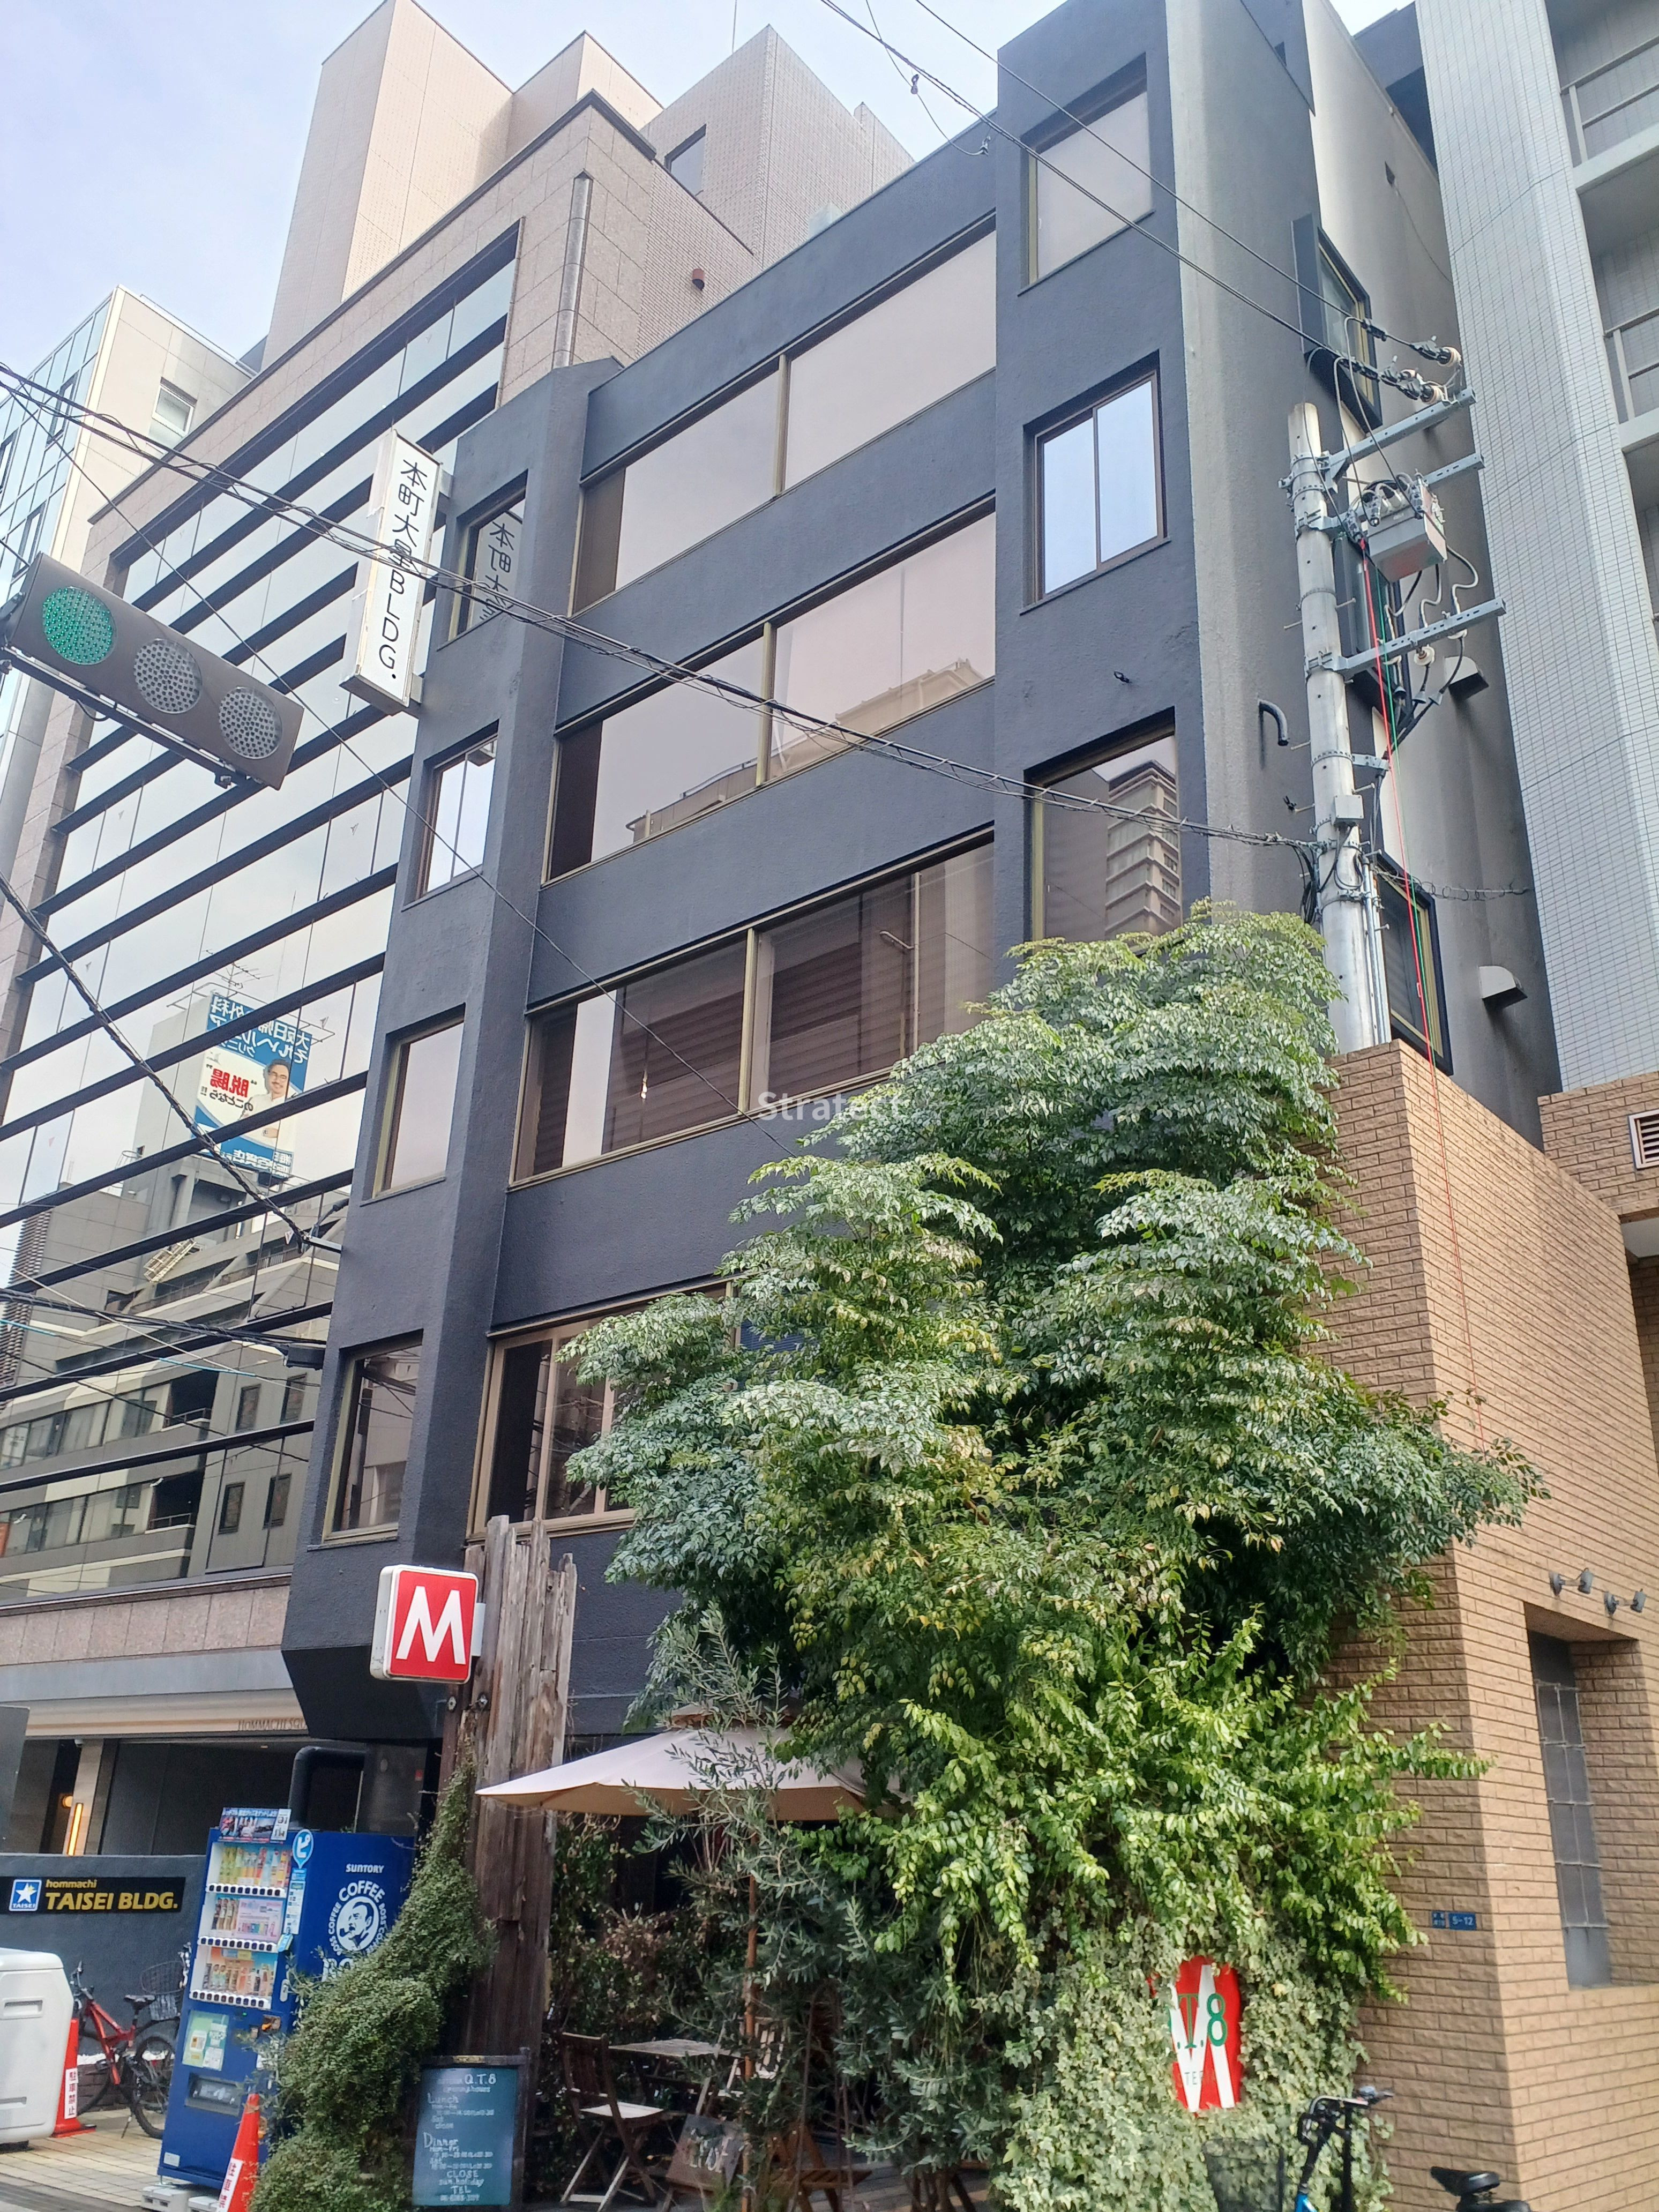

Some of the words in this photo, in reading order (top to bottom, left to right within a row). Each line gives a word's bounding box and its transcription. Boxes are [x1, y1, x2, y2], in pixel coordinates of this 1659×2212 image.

[395, 1586, 466, 1665] M
[346, 1863, 384, 1873] SUNTORY
[46, 1879, 97, 1888] hommachi
[339, 1880, 385, 1903] COFFEE
[45, 1893, 114, 1910] TAISEI
[118, 1892, 178, 1910] BLDG.
[446, 2170, 479, 2179] CLOSE
[450, 2185, 472, 2194] TEL
